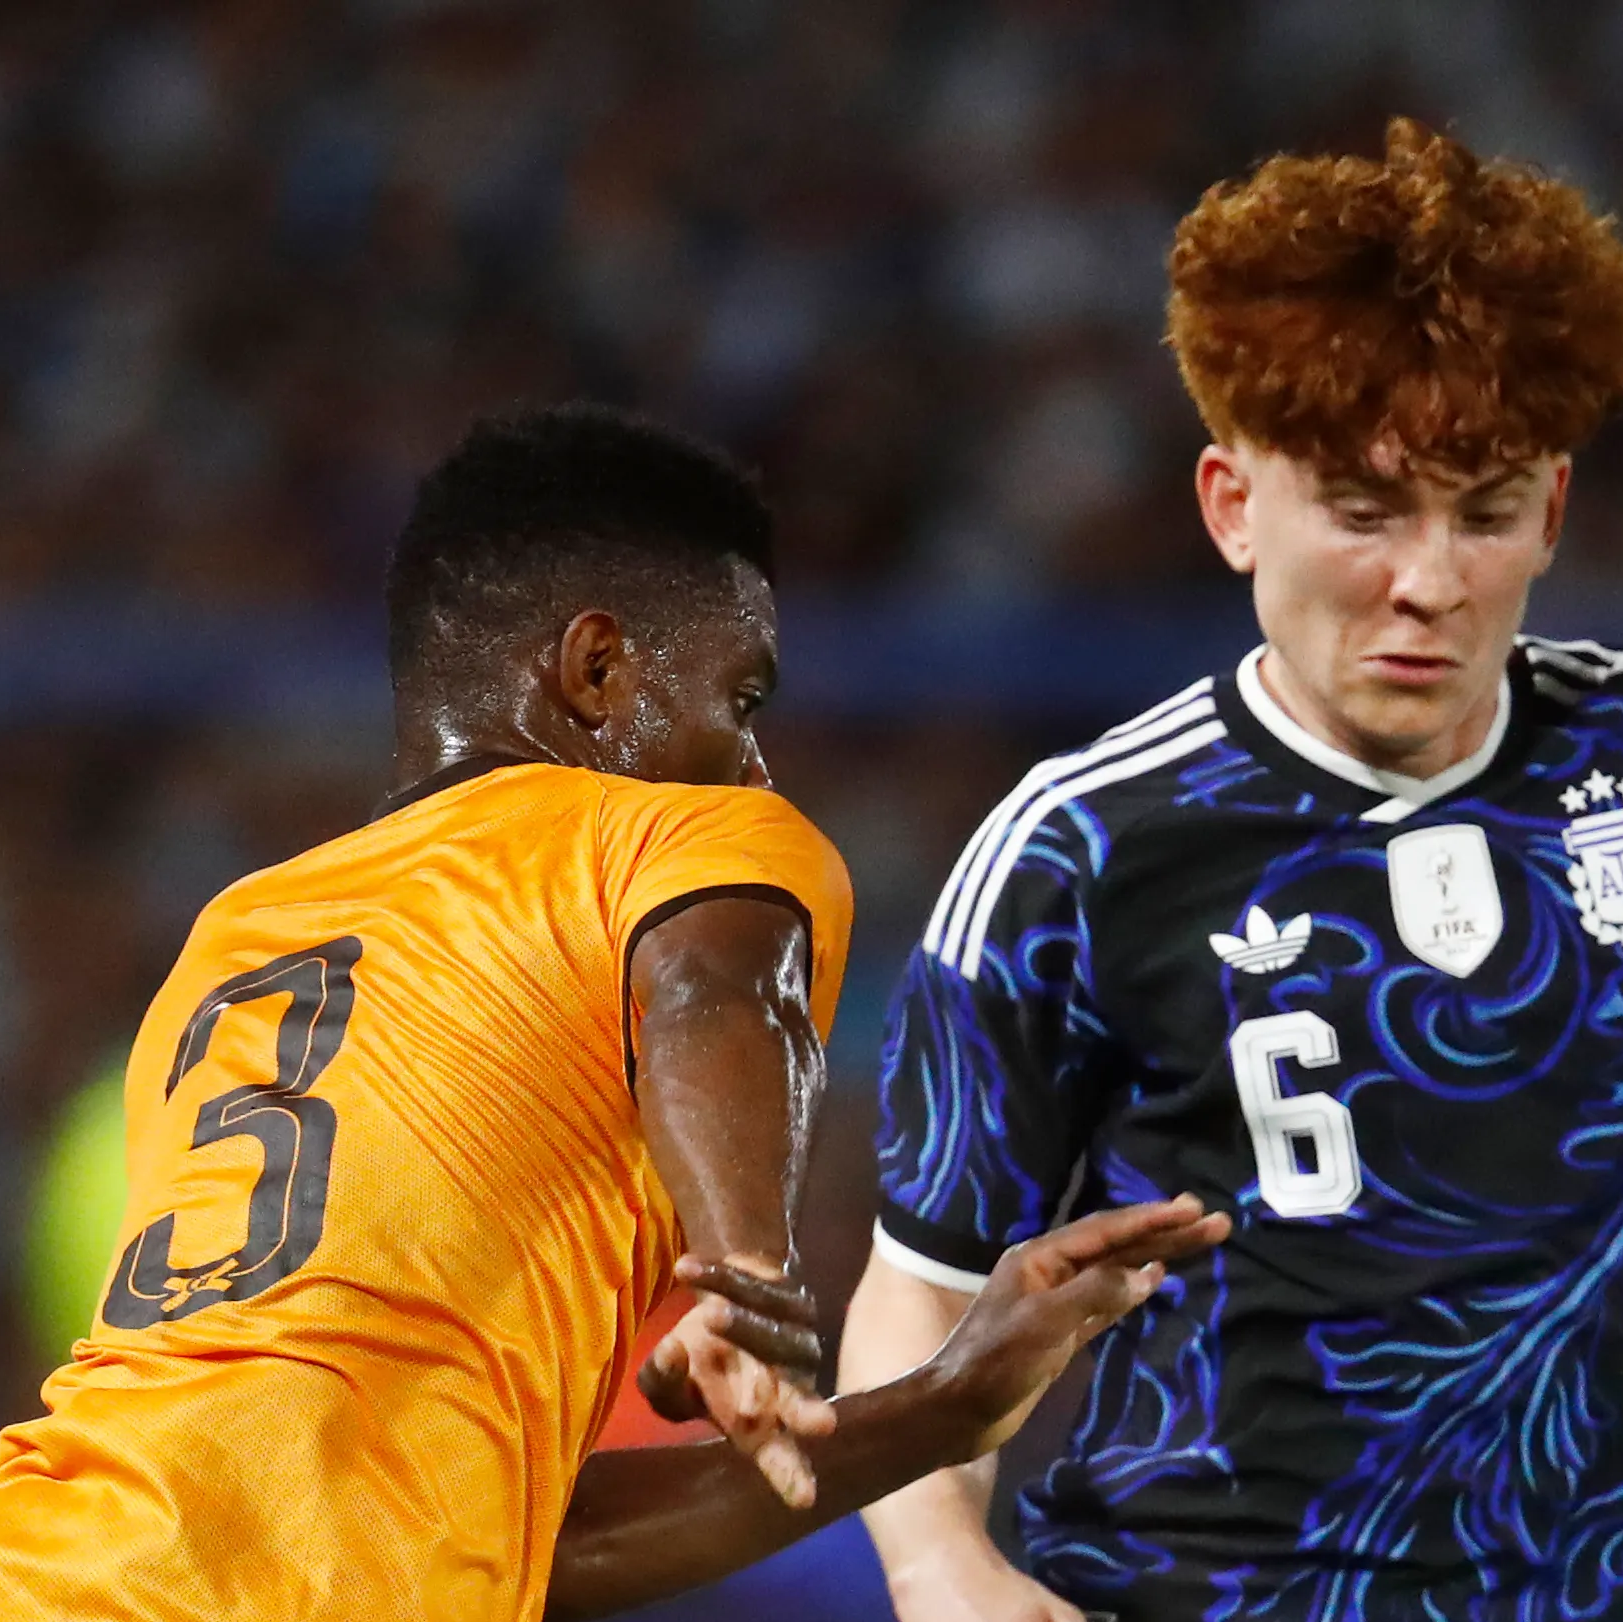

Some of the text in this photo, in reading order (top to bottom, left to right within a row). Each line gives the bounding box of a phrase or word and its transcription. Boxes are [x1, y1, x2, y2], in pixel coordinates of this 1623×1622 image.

[1433, 920, 1475, 938] FIFA
[103, 935, 363, 1330] 3
[1230, 1011, 1362, 1218] 6
